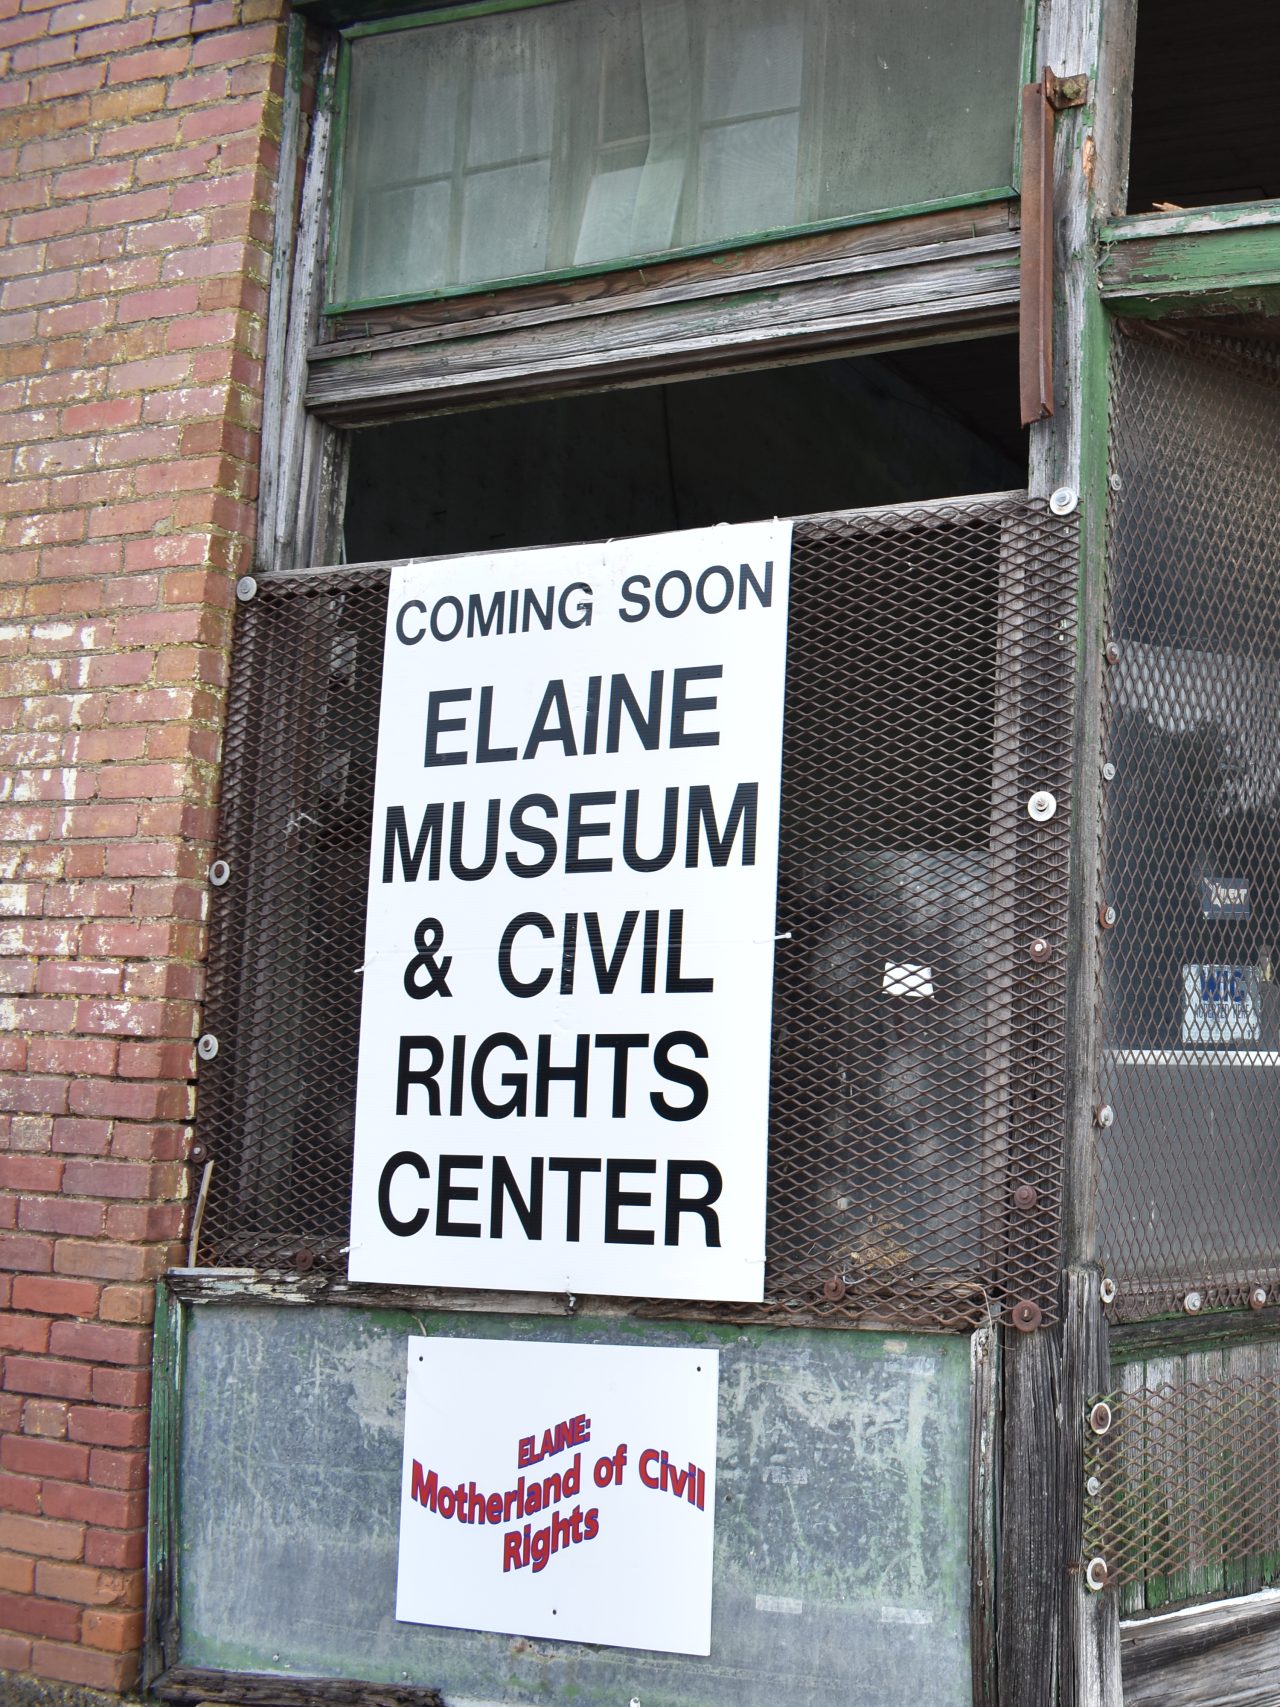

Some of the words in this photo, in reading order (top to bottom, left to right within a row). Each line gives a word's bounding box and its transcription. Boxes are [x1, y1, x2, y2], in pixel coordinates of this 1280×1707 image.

[396, 582, 593, 646] COMING
[618, 561, 774, 623] SOON
[423, 664, 723, 768] ELAINE
[382, 782, 759, 884] MUSEUM
[403, 917, 453, 1000] &
[498, 908, 714, 999] CIVIL
[395, 1030, 709, 1122] RIGHTS
[378, 1150, 723, 1248] CENTER
[411, 1452, 581, 1525] Motherland
[593, 1443, 628, 1488] of
[638, 1448, 706, 1512] Civil
[518, 1414, 591, 1469] ELAINE:
[503, 1505, 600, 1574] Rights
